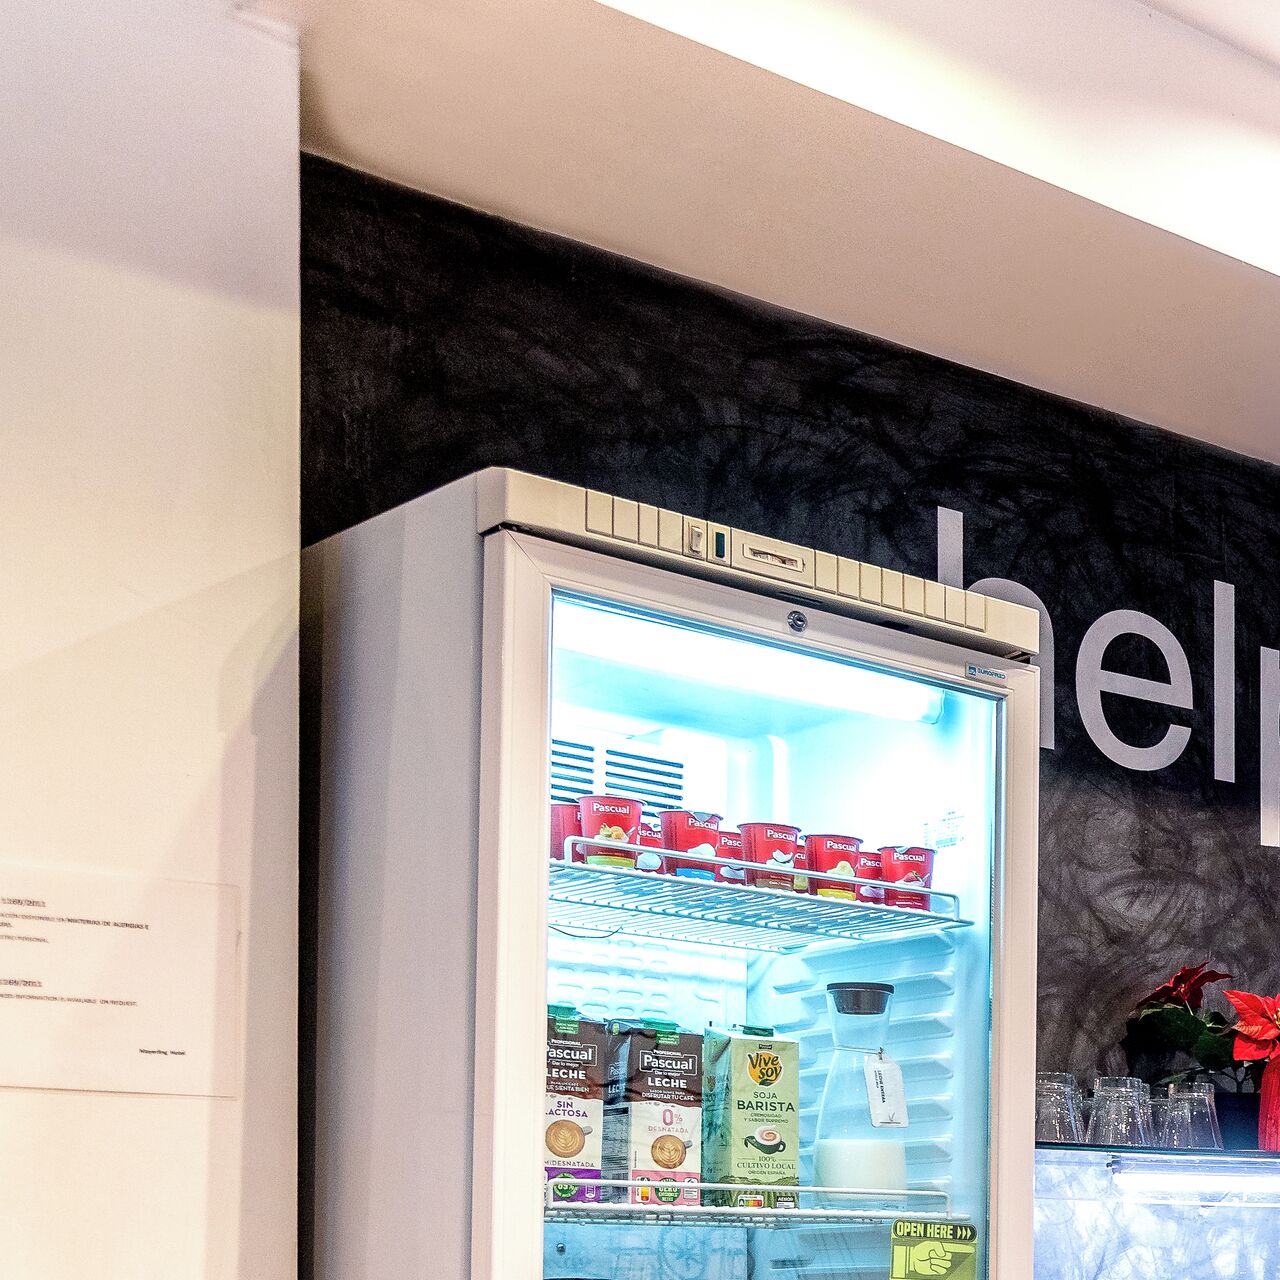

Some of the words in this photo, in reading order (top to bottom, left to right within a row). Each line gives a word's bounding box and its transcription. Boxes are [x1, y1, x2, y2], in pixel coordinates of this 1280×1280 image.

[593, 803, 629, 814] Pascual
[688, 818, 718, 830] Pascual
[767, 829, 796, 841] Pascual
[721, 837, 742, 847] Pasc
[827, 840, 857, 852] Pascual
[860, 858, 882, 867] Pasc
[894, 853, 925, 862] Pascual
[644, 1054, 693, 1070] Pascual
[748, 1053, 780, 1069] Vive
[759, 1066, 782, 1082] soy
[648, 1077, 687, 1089] LECHE
[753, 1091, 778, 1099] SOJA
[557, 1101, 573, 1109] SIN
[737, 1100, 795, 1112] BARISTA
[545, 1109, 588, 1118] ACTOSA
[663, 1109, 683, 1127] 0%
[648, 1126, 689, 1134] DESNATADA
[896, 1221, 925, 1237] OPEN
[926, 1223, 954, 1239] HERE
